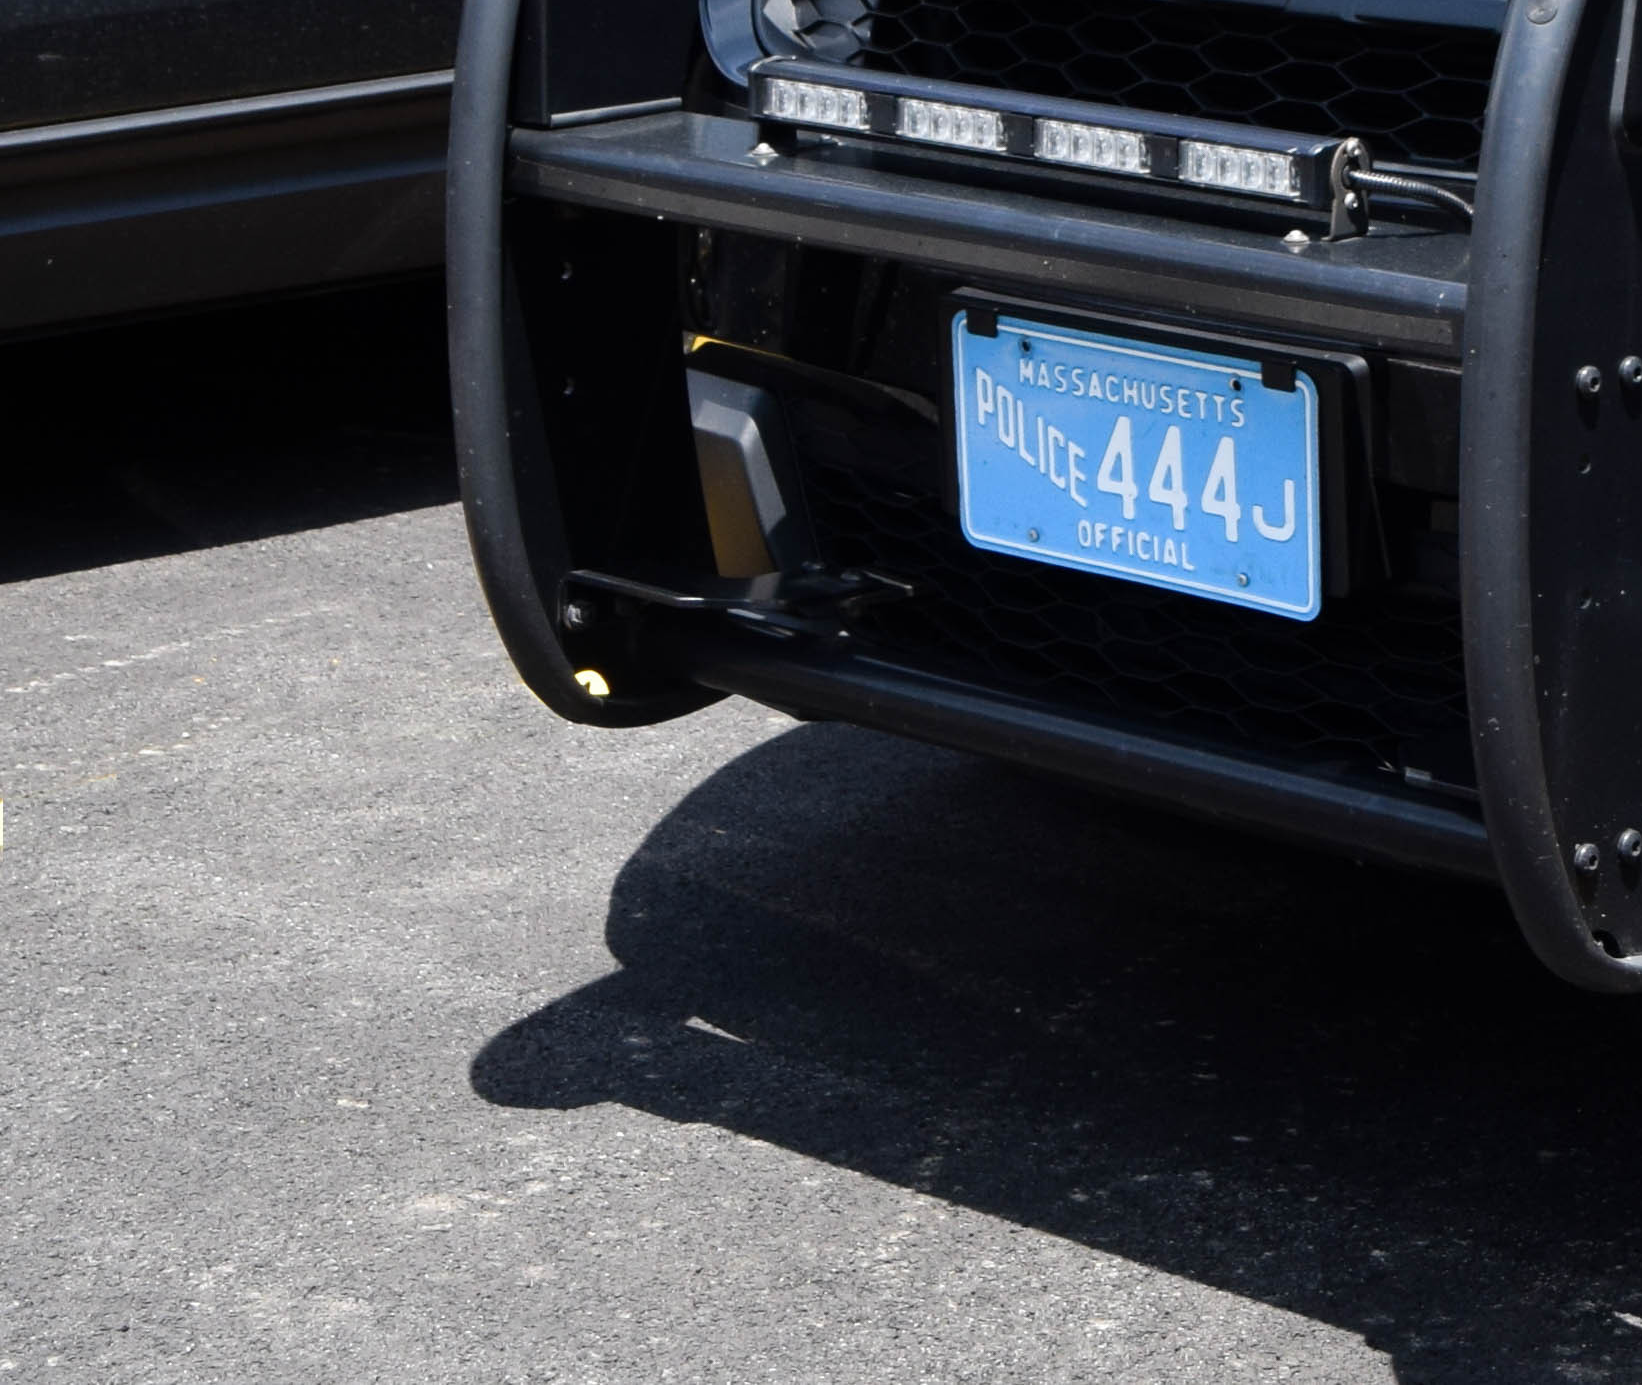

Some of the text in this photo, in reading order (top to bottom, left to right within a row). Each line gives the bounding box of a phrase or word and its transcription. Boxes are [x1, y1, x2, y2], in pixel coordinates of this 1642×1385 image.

[1019, 358, 1245, 428] MASSACHUSETTS
[976, 367, 1088, 508] POLICE
[1078, 520, 1195, 571] OFFICIAL
